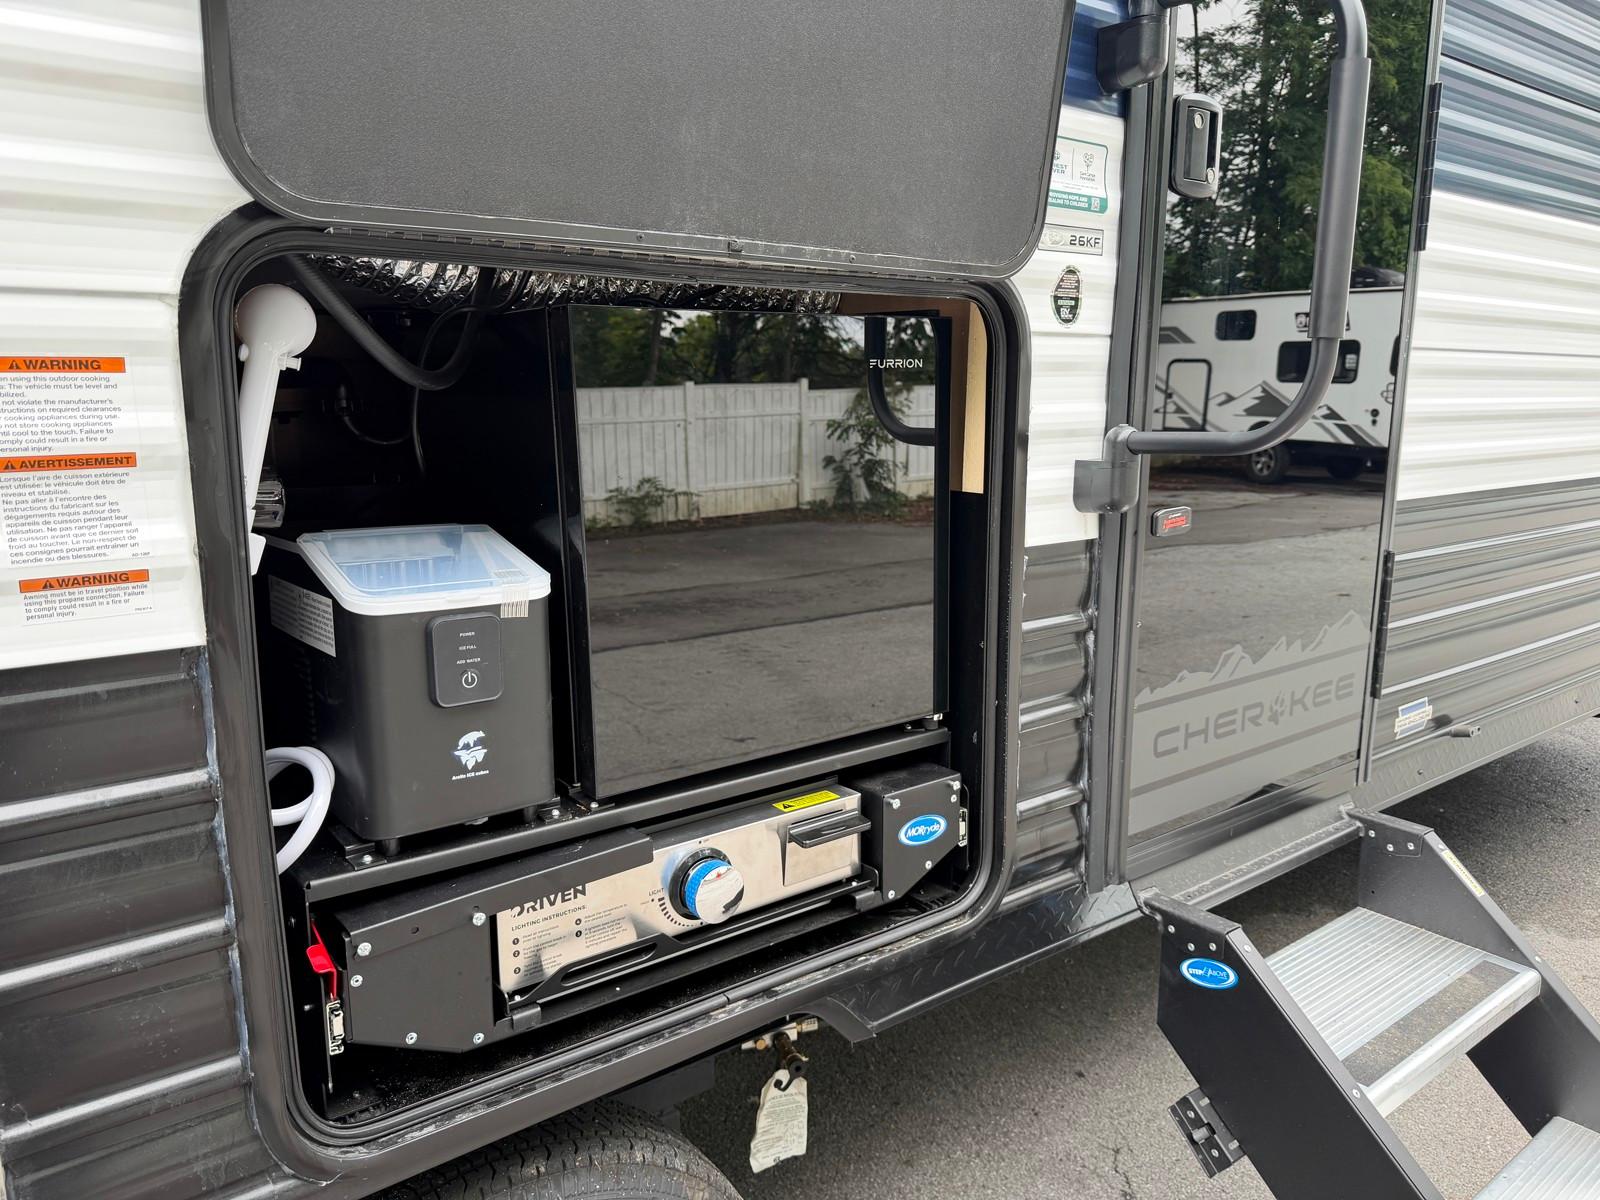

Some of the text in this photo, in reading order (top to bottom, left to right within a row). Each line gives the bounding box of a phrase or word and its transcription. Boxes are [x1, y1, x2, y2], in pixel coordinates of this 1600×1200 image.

[1069, 234, 1101, 248] 26KF
[23, 359, 102, 370] WARNING
[869, 358, 923, 369] FURRION
[10, 375, 31, 383] using
[80, 375, 110, 383] cooking
[58, 397, 113, 405] manufacturer's
[4, 414, 35, 422] cooking
[37, 414, 77, 422] appliances
[80, 413, 103, 421] during
[41, 421, 71, 429] cooking
[12, 429, 29, 437] cool
[31, 445, 54, 453] injury.
[20, 456, 132, 469] AVERTISSEMENT
[64, 472, 93, 480] cuisson
[86, 479, 100, 487] doit
[2, 498, 13, 506] Ne
[3, 504, 48, 513] instructions
[50, 503, 60, 511] du
[61, 501, 94, 510] fabricant
[53, 517, 83, 525] cuisson
[83, 514, 113, 524] pendant
[59, 525, 73, 533] pas
[74, 524, 98, 532] ranger
[25, 547, 65, 557] consignes
[129, 541, 140, 549] un
[45, 555, 55, 563] ou
[56, 554, 71, 562] des
[56, 572, 129, 588] WARNING
[23, 592, 49, 601] Awning
[50, 590, 67, 598] must
[68, 589, 76, 597] be
[85, 586, 104, 595] travel
[105, 583, 130, 593] position
[24, 600, 43, 608] using
[58, 595, 85, 604] propane
[124, 590, 145, 598] Failure
[33, 604, 57, 613] comply
[59, 602, 77, 610] could
[79, 600, 97, 608] result
[111, 597, 122, 605] fire
[26, 610, 77, 622] personal injury.
[648, 887, 665, 896] LIGHT
[511, 918, 541, 932] LIGHTING
